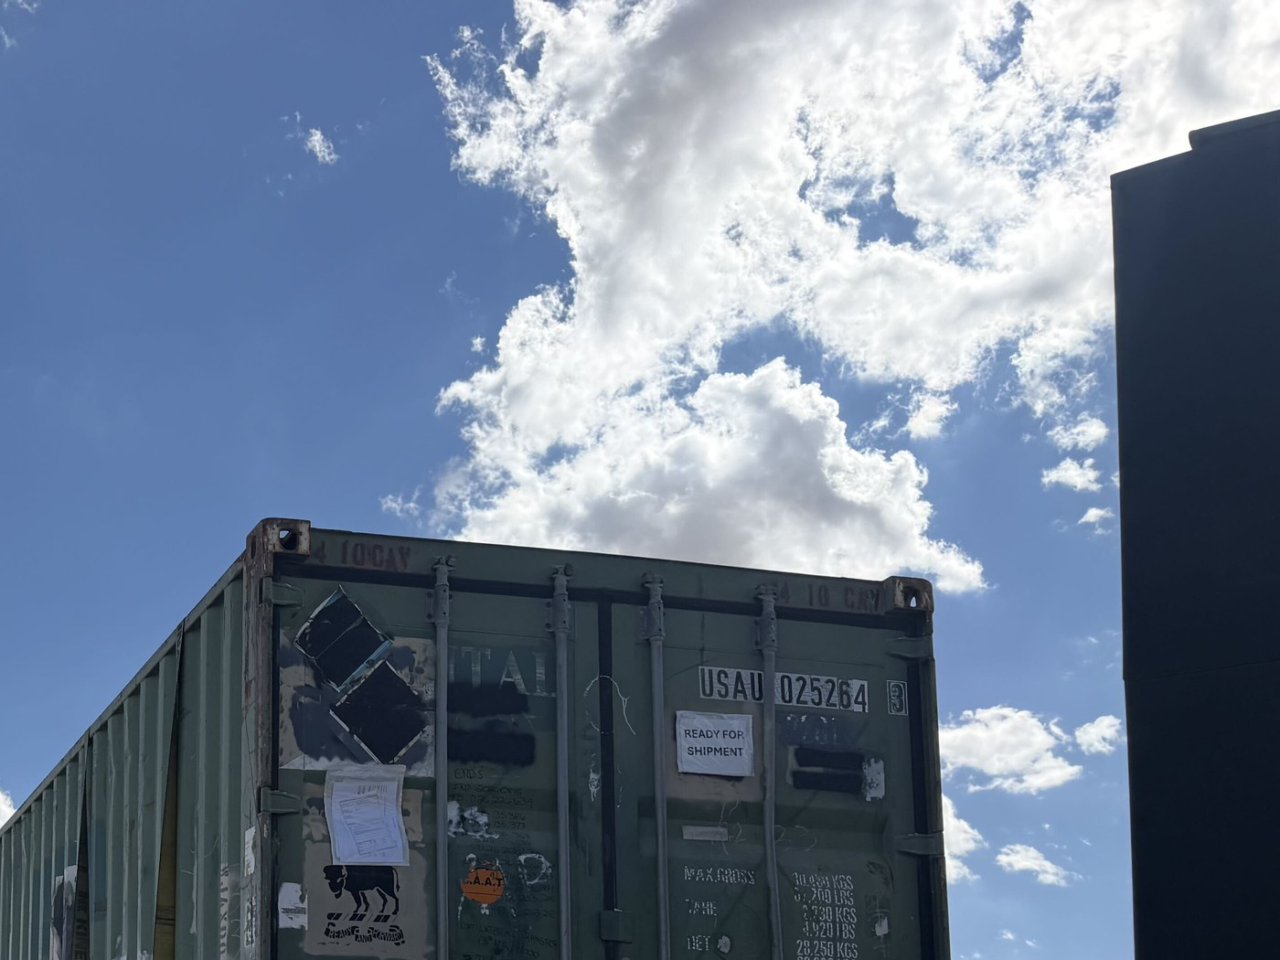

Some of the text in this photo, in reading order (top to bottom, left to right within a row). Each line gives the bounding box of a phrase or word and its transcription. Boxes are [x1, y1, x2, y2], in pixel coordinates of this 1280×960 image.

[700, 668, 764, 702] USAU
[780, 674, 868, 713] 025264
[684, 729, 745, 740] READY FOR
[687, 746, 744, 757] SHIPMENT
[835, 907, 857, 923] KGS
[796, 939, 834, 956] 28.250
[836, 942, 858, 958] KGS
